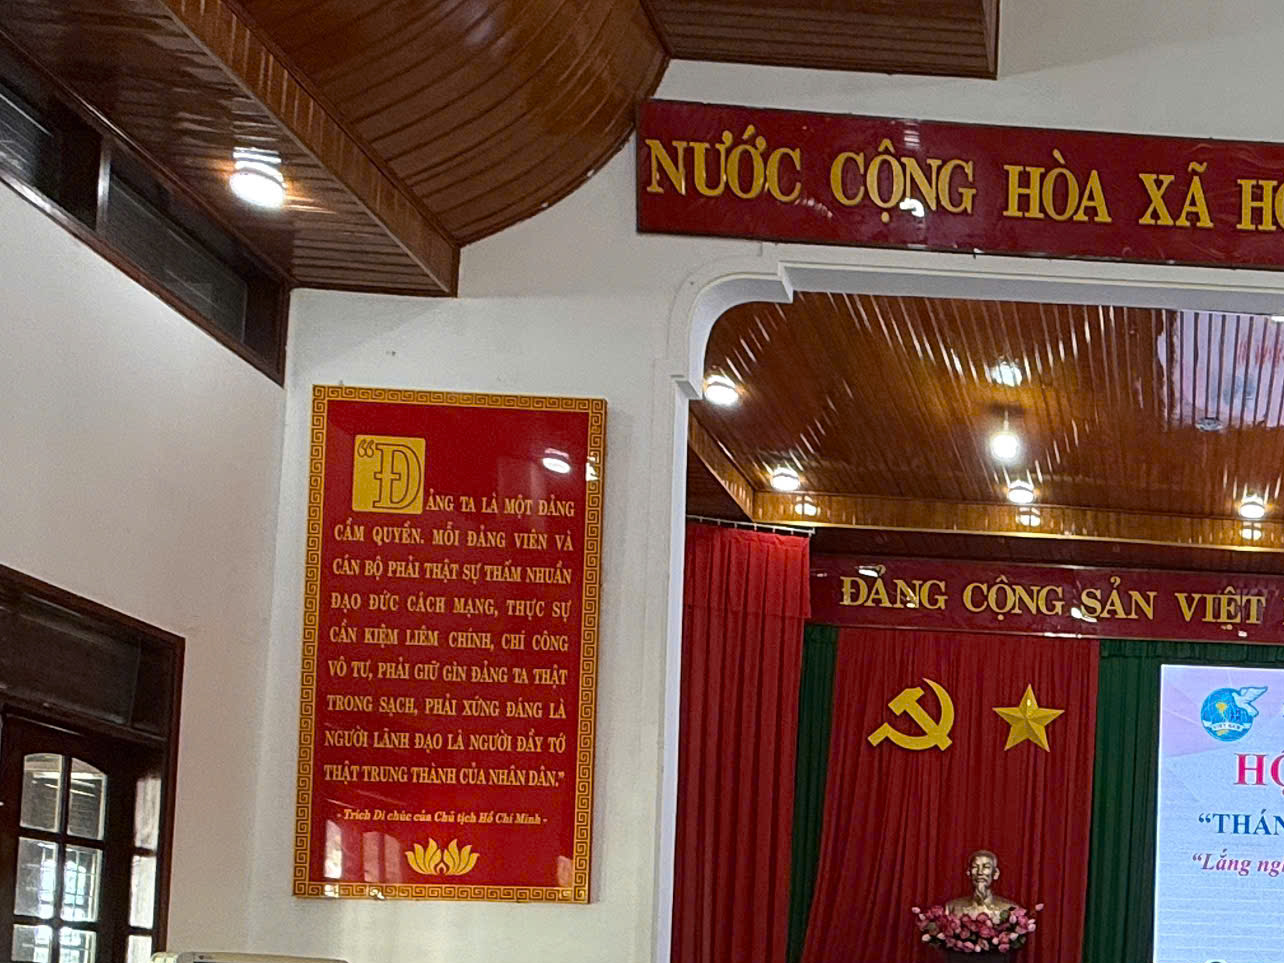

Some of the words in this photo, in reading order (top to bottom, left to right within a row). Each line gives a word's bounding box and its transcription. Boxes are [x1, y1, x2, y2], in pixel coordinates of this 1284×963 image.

[645, 124, 801, 202] NƯỚC
[830, 138, 977, 224] CỘNG
[1002, 149, 1112, 224] HÒA
[1138, 161, 1214, 228] XÃ
[504, 494, 533, 519] MỘT
[539, 494, 575, 517] ĐẢNG
[432, 521, 459, 546] MỖI
[467, 525, 506, 548] ĐẢNG
[514, 529, 547, 549] VIÊN
[333, 554, 360, 575] CÁN
[387, 555, 420, 578] PHẢI
[424, 559, 459, 583] THẬT
[484, 559, 521, 582] THẤM
[331, 592, 361, 613] ĐẠO
[368, 590, 399, 610] ĐỨC
[407, 591, 445, 613] CÁCH
[453, 597, 499, 618] MẠNG,
[506, 599, 545, 620] THỰC
[839, 564, 948, 610] ĐẢNG
[962, 575, 1065, 621] CỘNG
[1080, 576, 1155, 620] SẢN
[1174, 586, 1266, 630] VIỆT
[364, 624, 398, 648] KIỆM
[405, 625, 439, 646] LIÊM
[449, 627, 494, 651] CHÍNH,
[502, 630, 525, 650] CHÍ
[532, 630, 568, 651] CÔNG
[351, 659, 373, 681] TƯ,
[377, 656, 409, 679] PHẢI
[414, 660, 439, 680] GIỮ
[443, 661, 467, 681] GÌN
[471, 660, 508, 683] ĐẢNG
[533, 664, 568, 688] THẬT
[327, 695, 373, 712] TRONG
[379, 697, 418, 717] SẠCH,
[425, 693, 457, 715] PHẢI
[462, 696, 500, 716] XỨNG
[506, 697, 542, 718] ĐÁNG
[324, 725, 368, 748] NGƯỜI
[373, 728, 410, 749] LÃNH
[414, 733, 442, 753] ĐẠO
[469, 729, 513, 751] NGƯỜI
[324, 760, 360, 784] THẬT
[361, 766, 408, 784] TRUNG
[411, 763, 457, 784] THÀNH
[460, 762, 486, 785] CỦA
[489, 765, 526, 786] NHÂN
[1192, 849, 1251, 877] “Lắng
